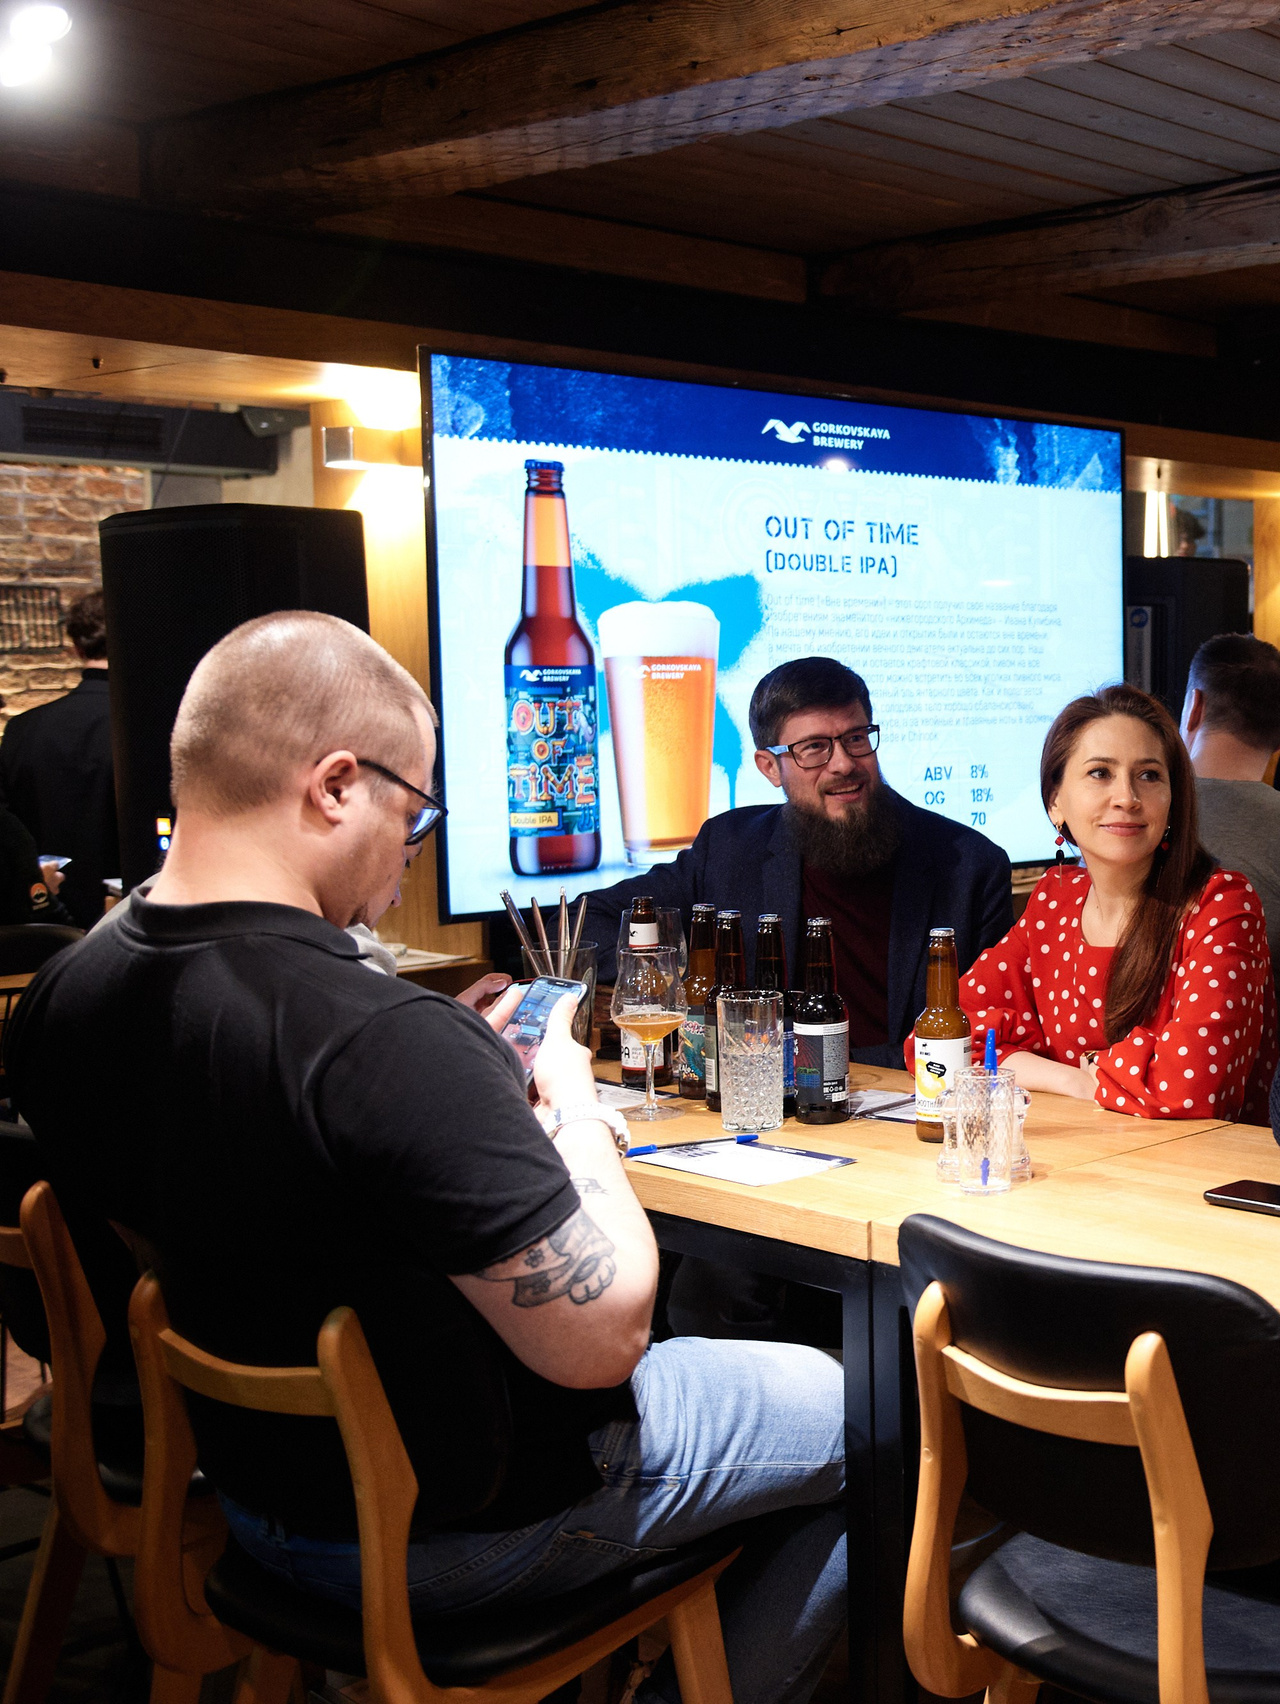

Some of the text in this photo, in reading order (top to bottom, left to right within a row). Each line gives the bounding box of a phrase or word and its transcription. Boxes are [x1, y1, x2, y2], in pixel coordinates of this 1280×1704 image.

[812, 422, 891, 440] GORKOVSKAYA
[813, 435, 864, 450] BREWERY
[765, 515, 919, 546] OUT OF TIME
[512, 697, 583, 737] OUT
[532, 738, 567, 766] OF
[924, 764, 989, 781] ABV 8%
[924, 787, 994, 805] OG 18%
[539, 815, 553, 824] IPA
[971, 812, 987, 826] 70
